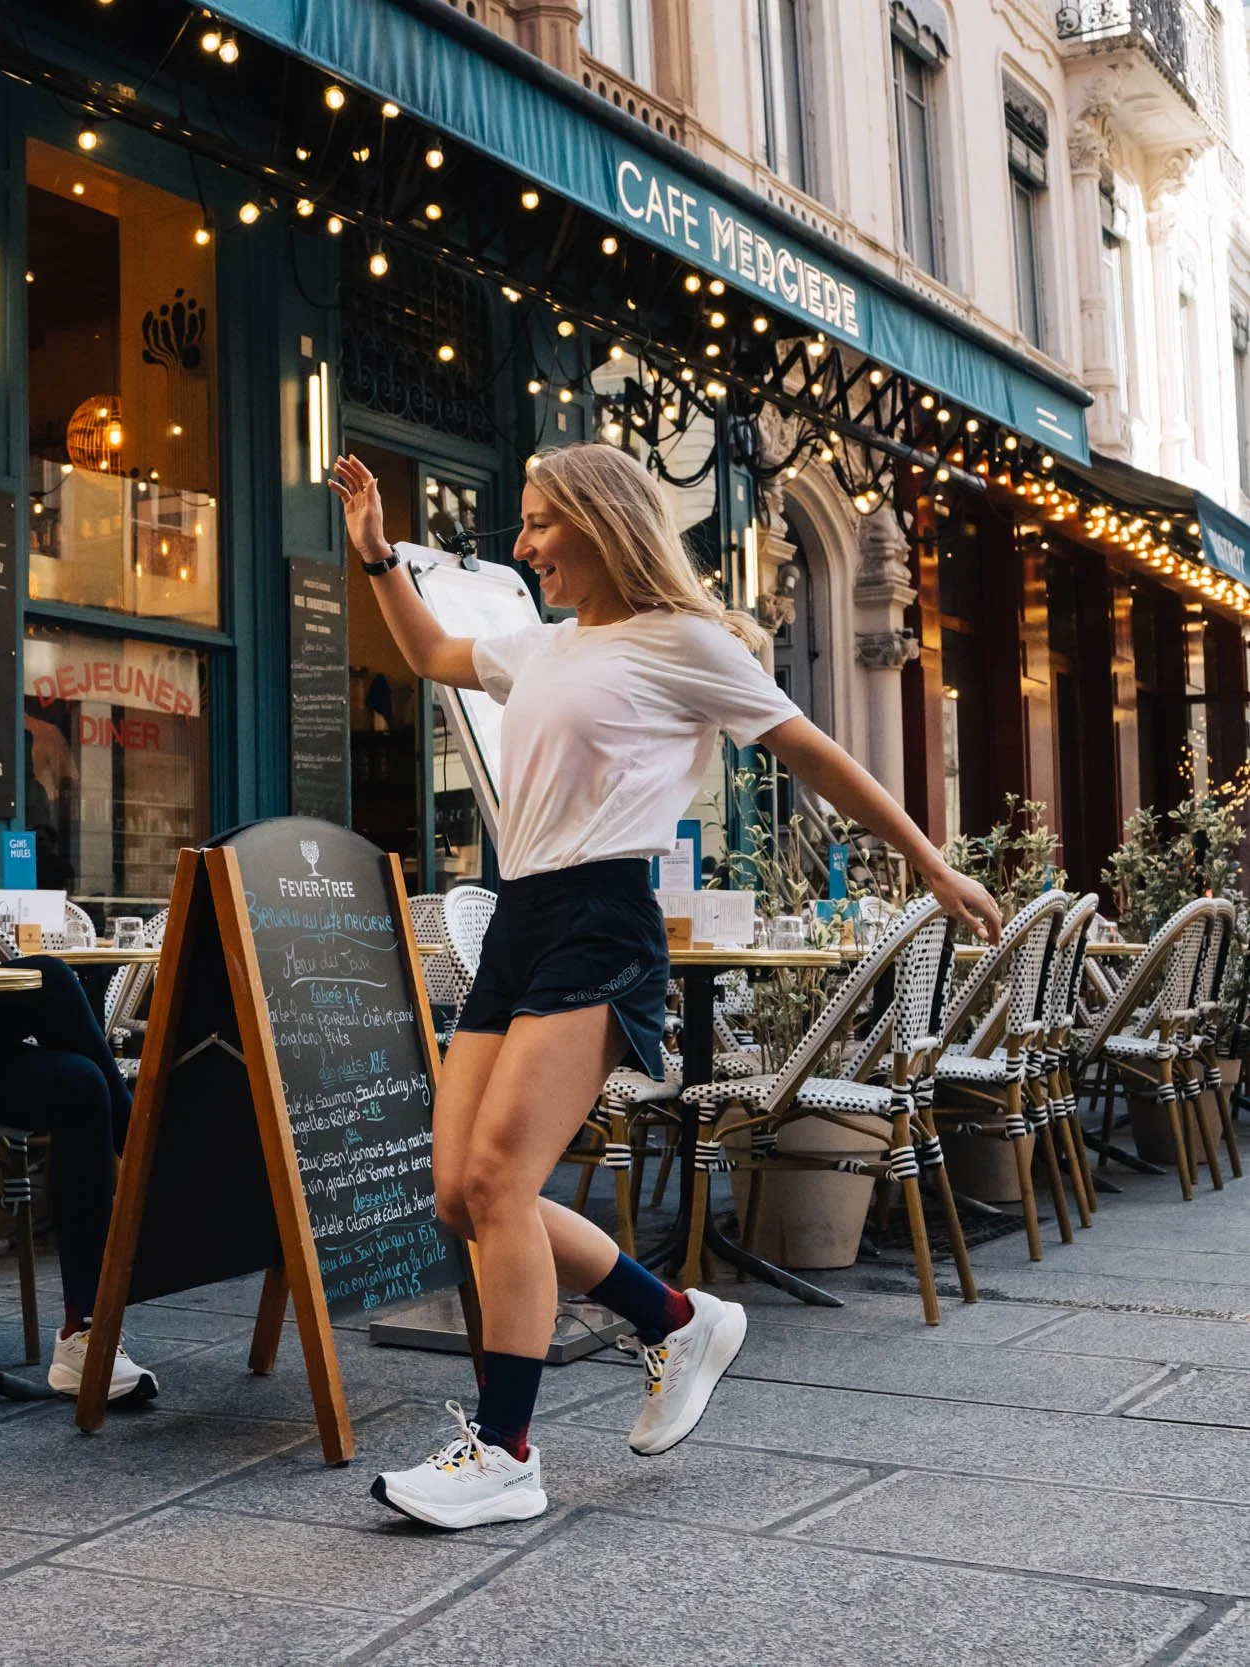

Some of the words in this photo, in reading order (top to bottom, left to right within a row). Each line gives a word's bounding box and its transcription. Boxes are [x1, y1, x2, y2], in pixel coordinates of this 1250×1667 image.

[617, 160, 701, 250] CAFE
[708, 206, 860, 338] MERCIERE
[32, 662, 194, 726] DEJEUNER
[78, 713, 162, 752] DINER
[9, 838, 28, 849] GINS
[10, 848, 31, 859] MULES
[269, 997, 290, 1024] arte
[502, 1471, 534, 1489] SALOMON
